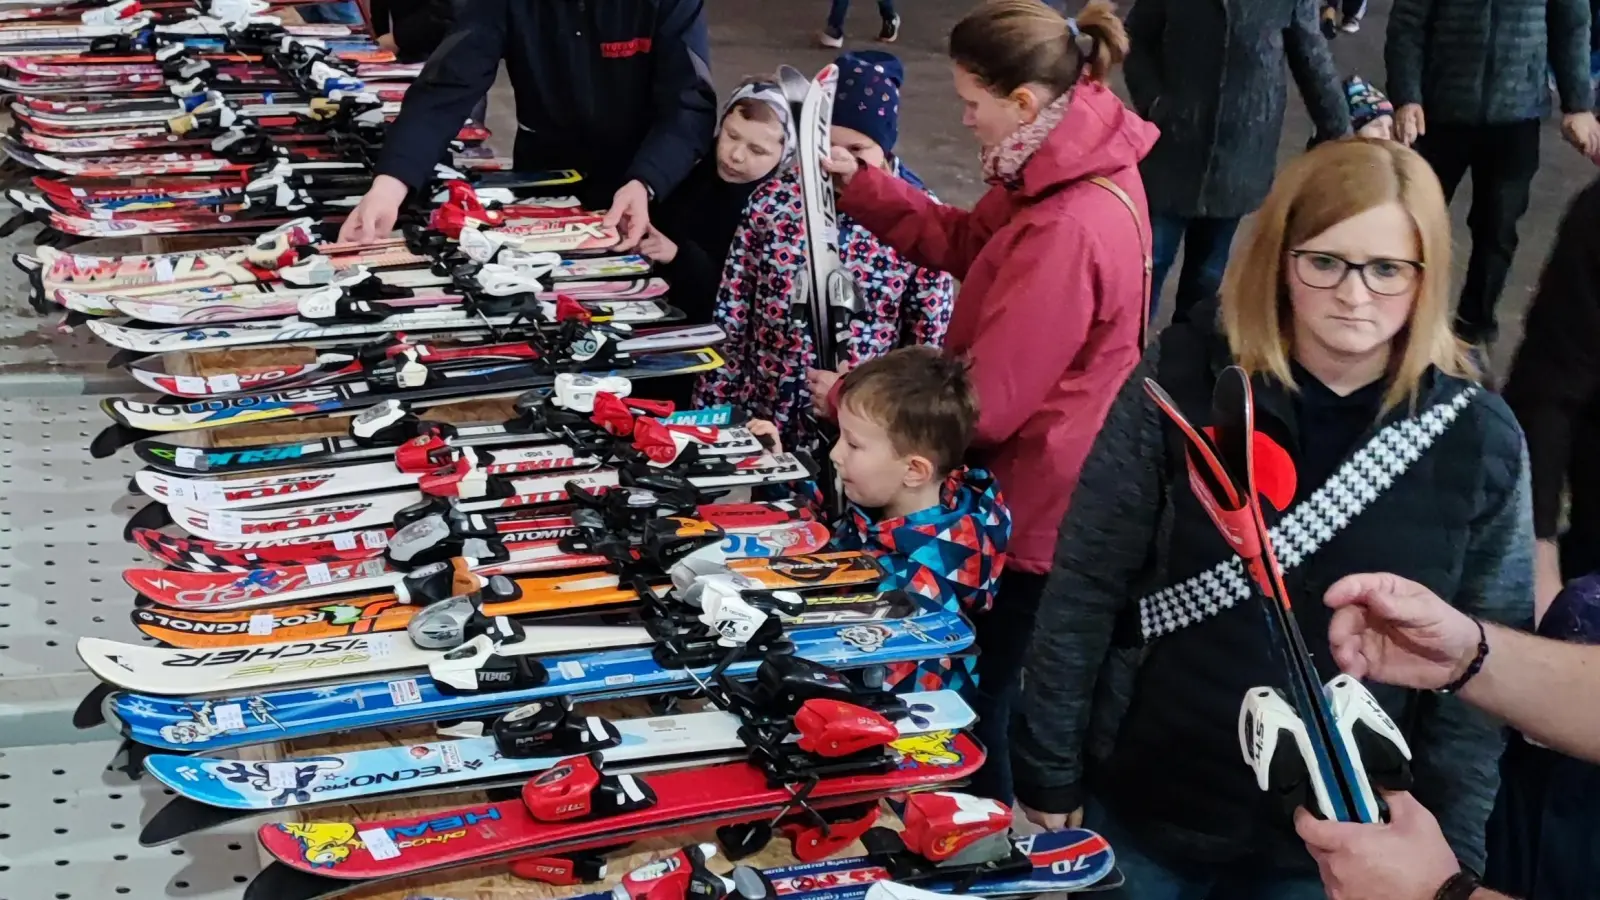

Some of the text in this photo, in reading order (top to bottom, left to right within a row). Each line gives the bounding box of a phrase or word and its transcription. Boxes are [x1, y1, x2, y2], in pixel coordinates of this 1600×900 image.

[501, 527, 581, 544] ATOMIC
[154, 612, 325, 634] ROSIGNOL
[387, 808, 502, 840] HEA
[1052, 855, 1091, 874] 70
